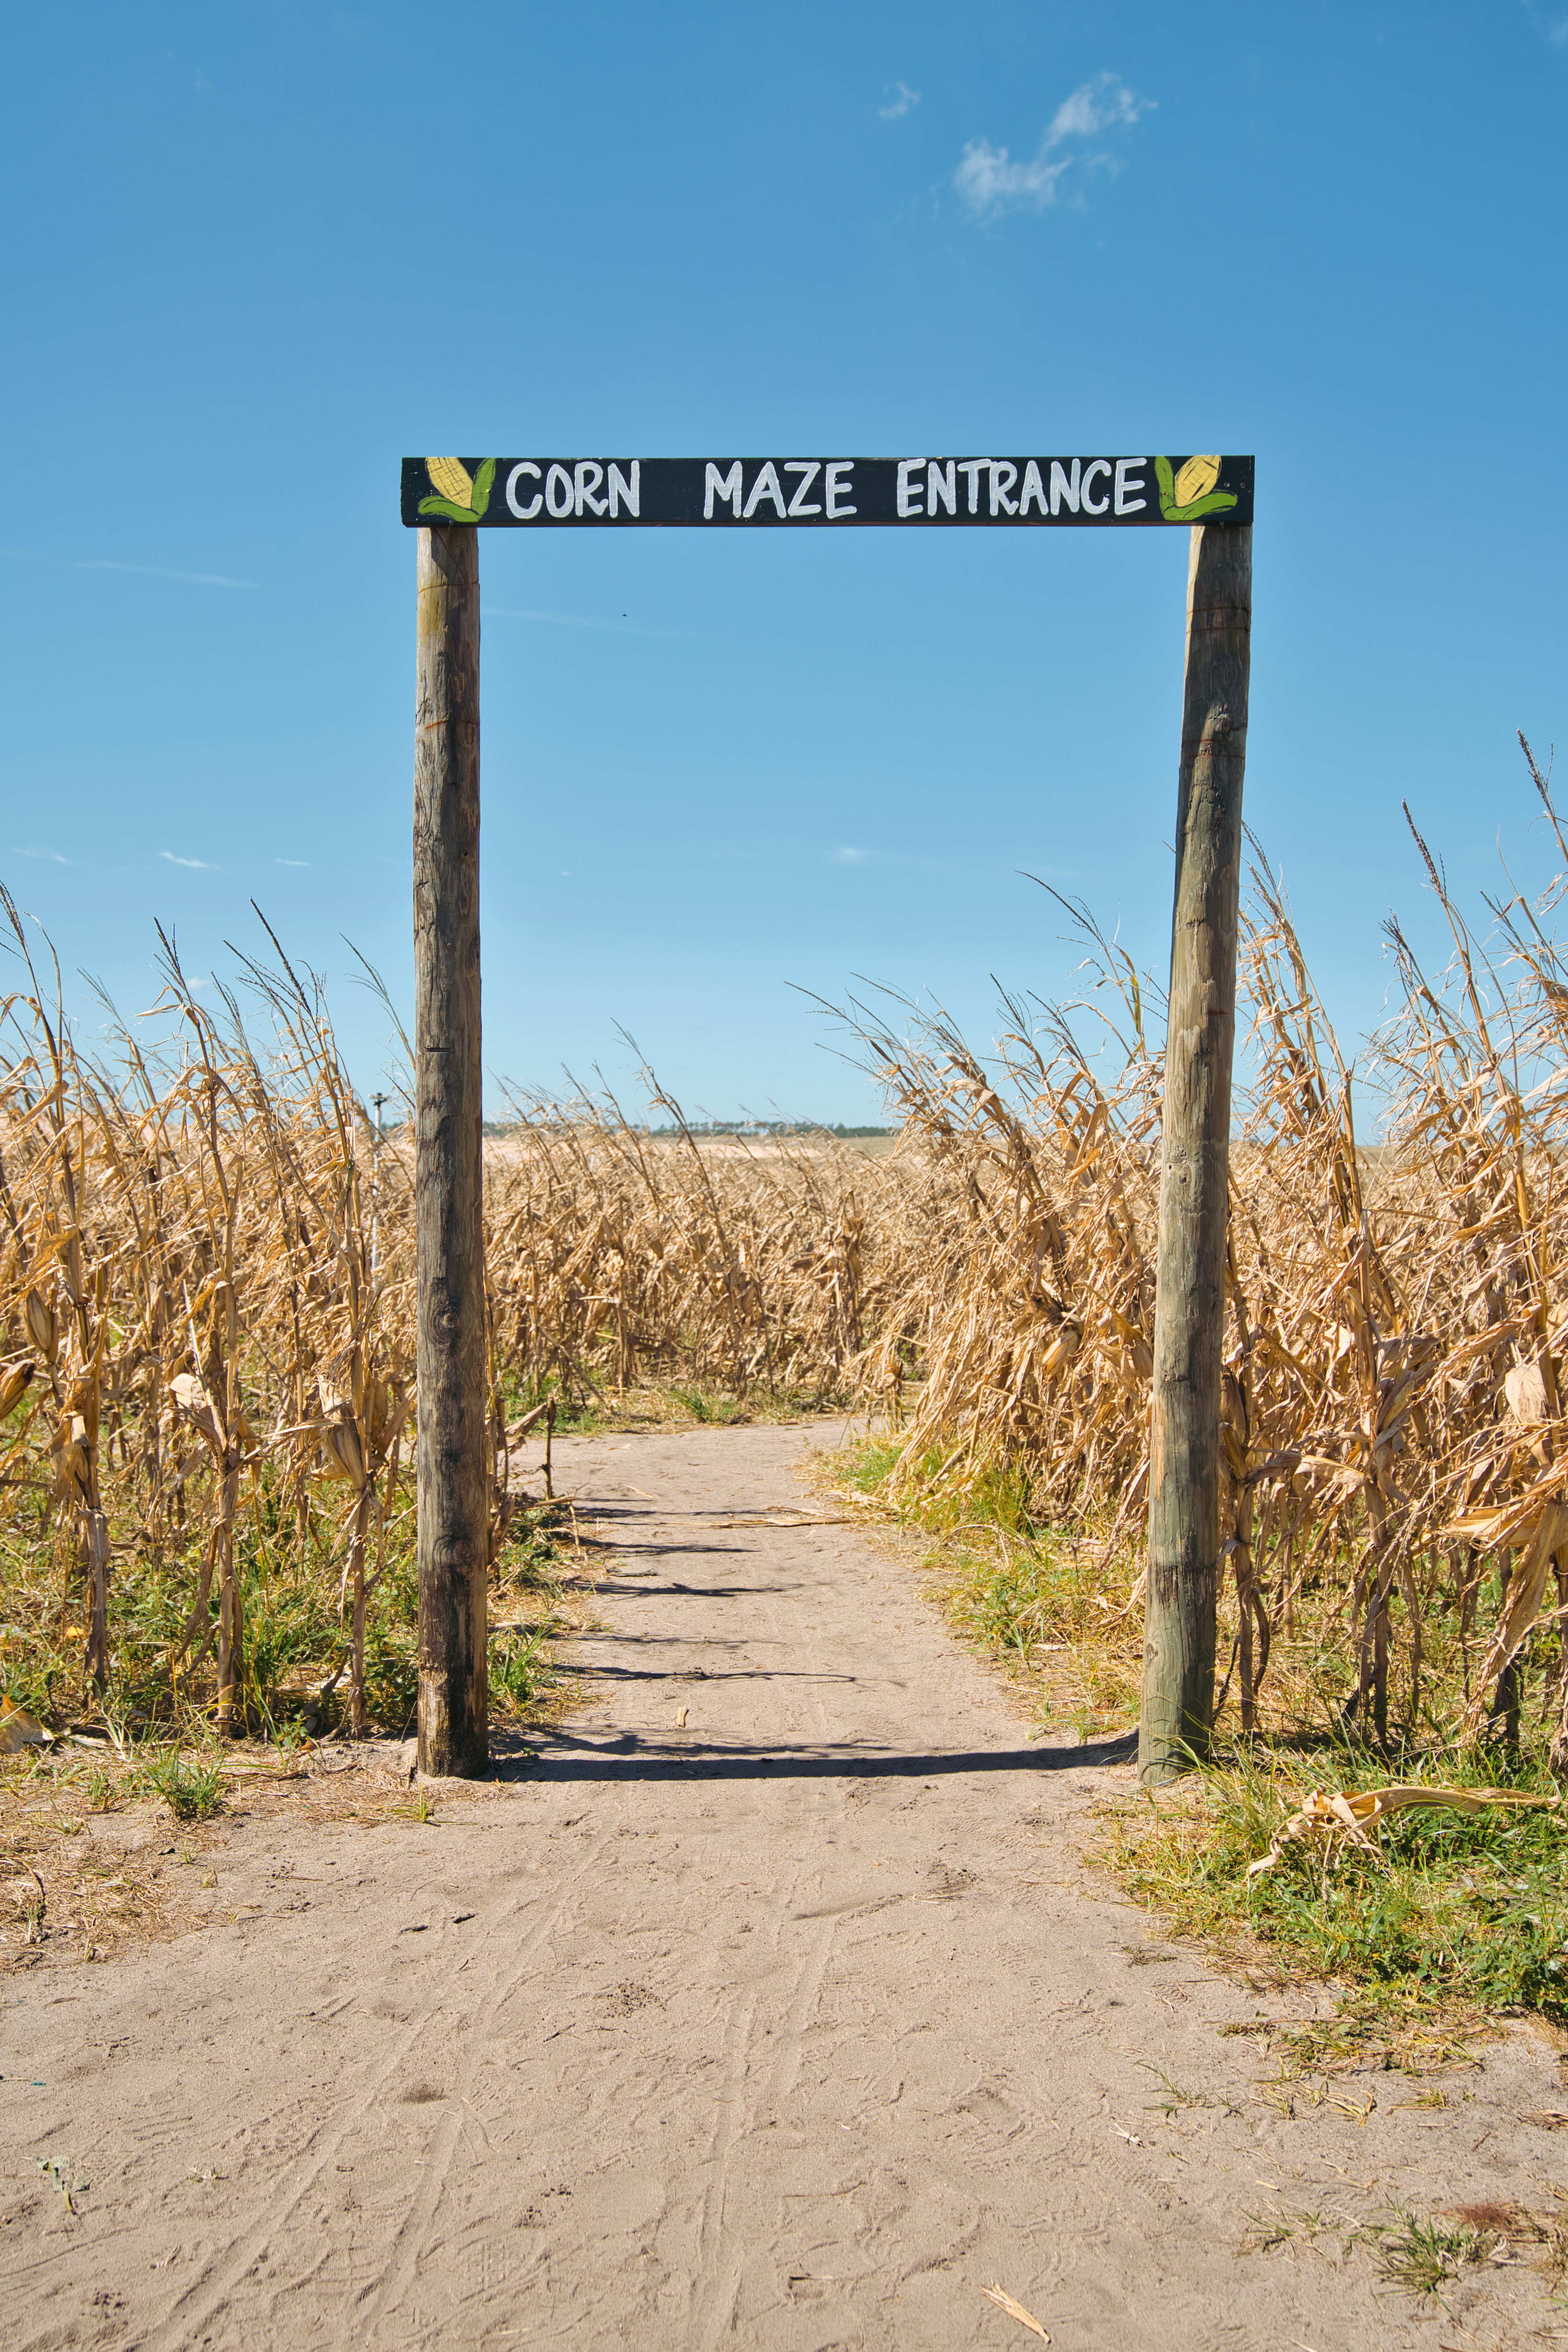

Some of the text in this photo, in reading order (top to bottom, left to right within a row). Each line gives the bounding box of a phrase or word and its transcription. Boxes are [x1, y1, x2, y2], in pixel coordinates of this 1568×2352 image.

[505, 457, 1148, 520] CORN MAZE ENTRANCE
